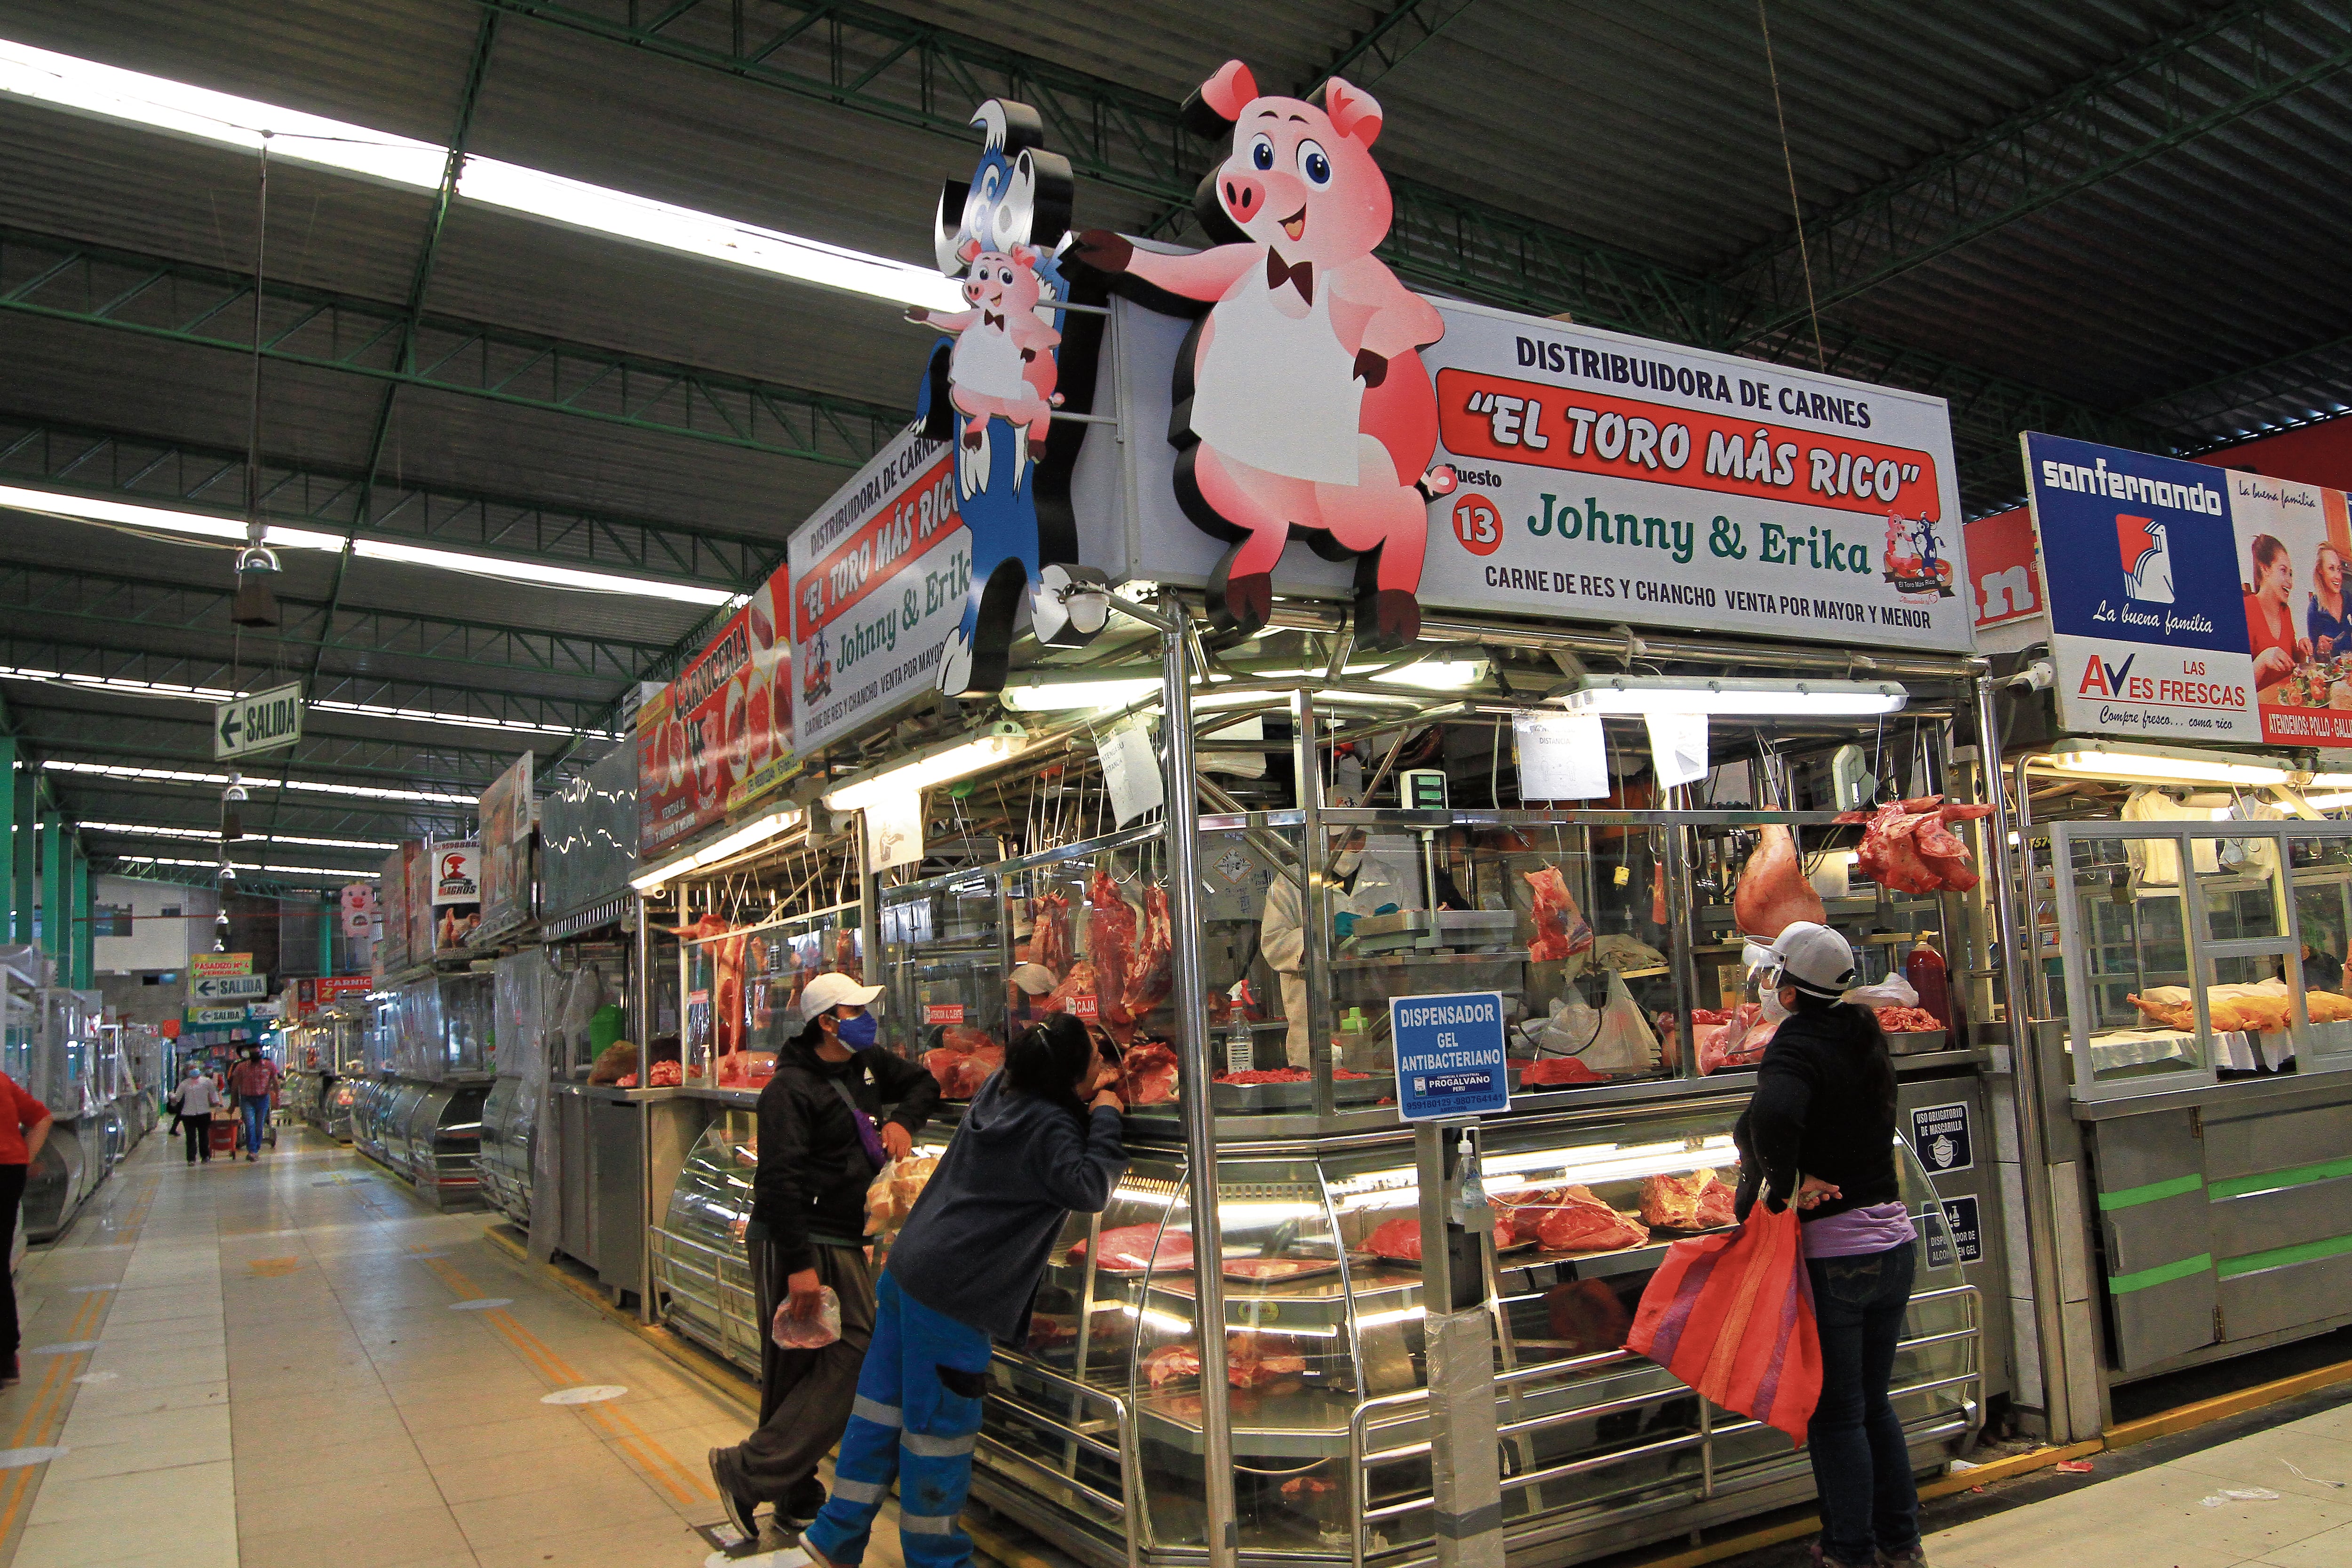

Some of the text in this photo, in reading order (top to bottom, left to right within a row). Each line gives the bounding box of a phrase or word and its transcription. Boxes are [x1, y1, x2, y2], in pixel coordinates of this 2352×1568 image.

[1516, 336, 1871, 429] DISTRIBUIDORA DE CARNES
[1567, 406, 1691, 470] TORO
[1705, 429, 1798, 486] MÁS
[810, 438, 943, 558] DISTRIBUIDORA DE CARNE
[2042, 457, 2223, 517] sanfernando
[2239, 479, 2316, 509] La buena familia
[1456, 505, 1497, 544] 13
[1527, 493, 1872, 574] Johnny & Erika
[829, 539, 871, 607] TORO
[874, 501, 915, 573] MÁS
[1485, 565, 1931, 629] CARNE DE RES Y CHANCHO VENTA POR MAYOR Y MENOR
[836, 549, 971, 674] Johnny & Erik
[2092, 599, 2214, 635] La buena familia
[674, 621, 750, 721] CARNICERIA
[2078, 653, 2246, 707] AVES FRESCAS
[2183, 660, 2206, 676] LAS
[805, 713, 823, 737] CARNE
[823, 708, 830, 726] DE
[831, 701, 842, 721] RES
[843, 698, 848, 715] Y
[848, 680, 878, 712] CHANCHO
[880, 666, 903, 693] VENTA
[903, 657, 918, 681] POR
[246, 695, 296, 743] SALIDA
[2099, 705, 2139, 726] Compre
[2188, 717, 2213, 728] coma
[2215, 717, 2233, 730] rico
[2268, 713, 2309, 736] ATENDEMOS:
[2308, 716, 2330, 737] POLLO
[2334, 717, 2352, 738] GALLI
[220, 978, 263, 995] SALIDA
[325, 978, 371, 987] CARNIC
[213, 1011, 240, 1020] SALIDA
[1077, 1000, 1096, 1013] CAJA
[1400, 1003, 1494, 1028] DISPENSADOR
[1437, 1032, 1459, 1048] GEL
[1401, 1049, 1501, 1072] ANTIBACTERIANO
[1429, 1075, 1490, 1088] PROGALVANO
[1916, 1107, 1963, 1124] USO OBLIGATORIO
[1921, 1120, 1963, 1137] DE MASCARILLA
[1930, 1230, 1976, 1247] DISPADOR DE
[1932, 1244, 1977, 1261] ALCO EN GEL
